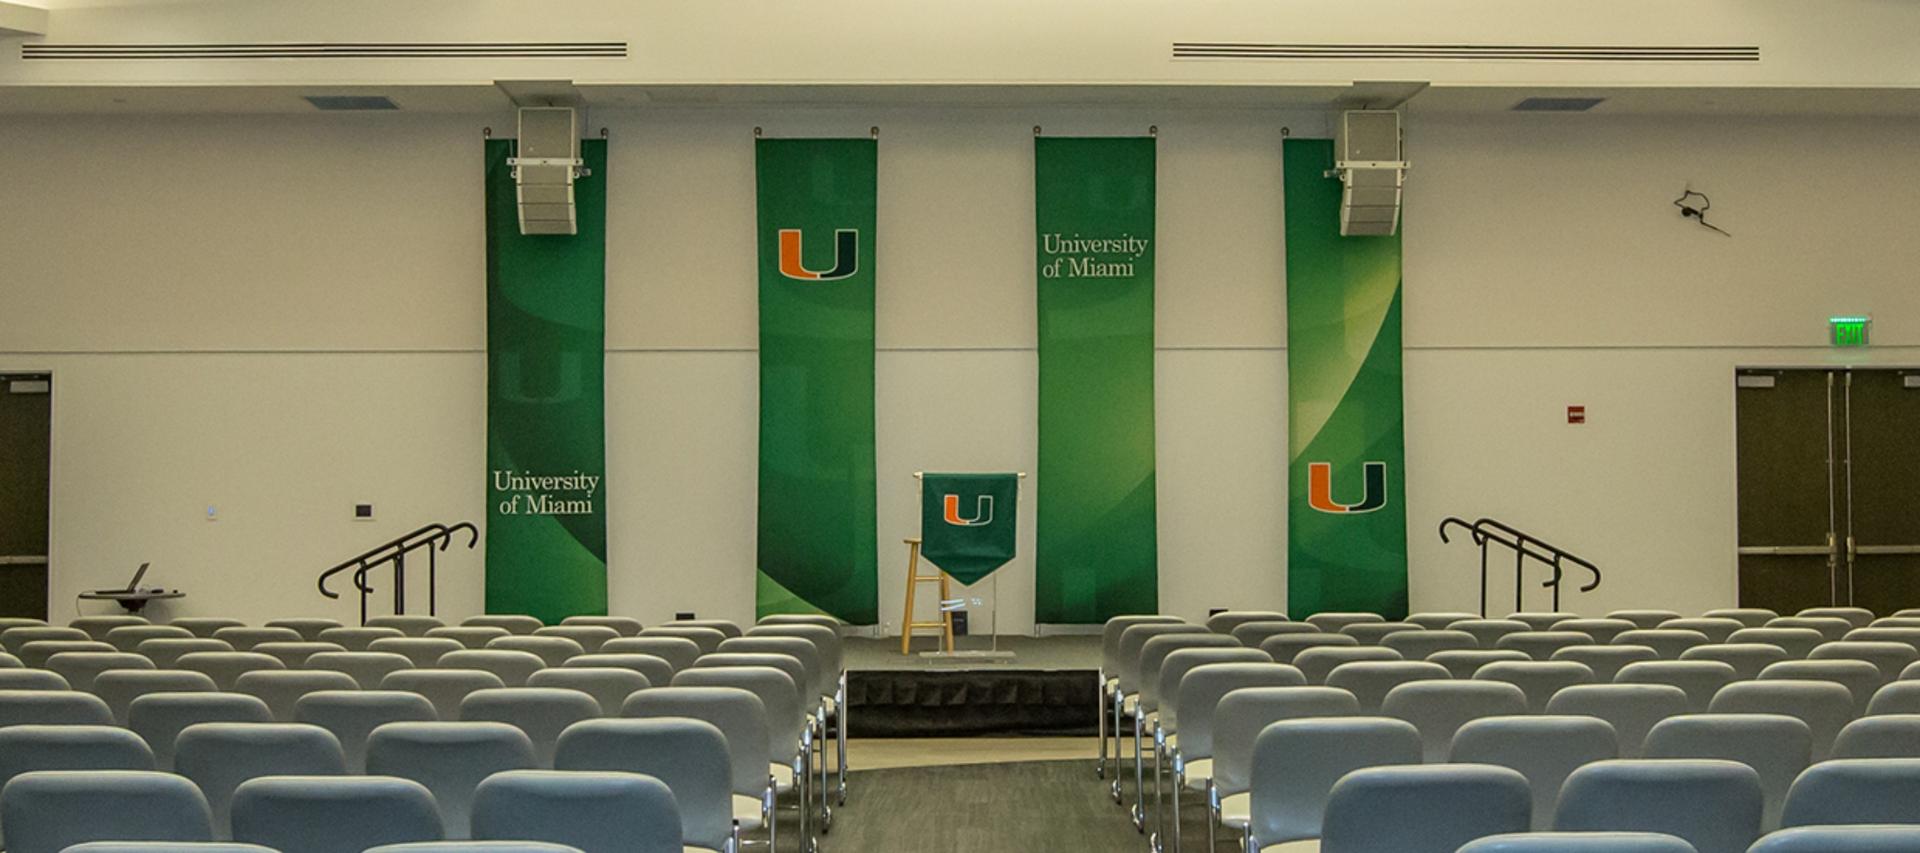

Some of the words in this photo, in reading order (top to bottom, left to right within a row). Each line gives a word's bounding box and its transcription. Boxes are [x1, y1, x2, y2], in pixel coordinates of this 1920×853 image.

[778, 228, 859, 281] U
[1042, 233, 1148, 257] University
[1042, 257, 1064, 278] of
[1067, 257, 1135, 277] Miami
[1836, 322, 1864, 346] EXIT
[493, 469, 599, 494] University
[1308, 461, 1387, 514] U
[499, 494, 521, 515] of
[525, 494, 593, 514] Miami
[943, 494, 994, 526] U
